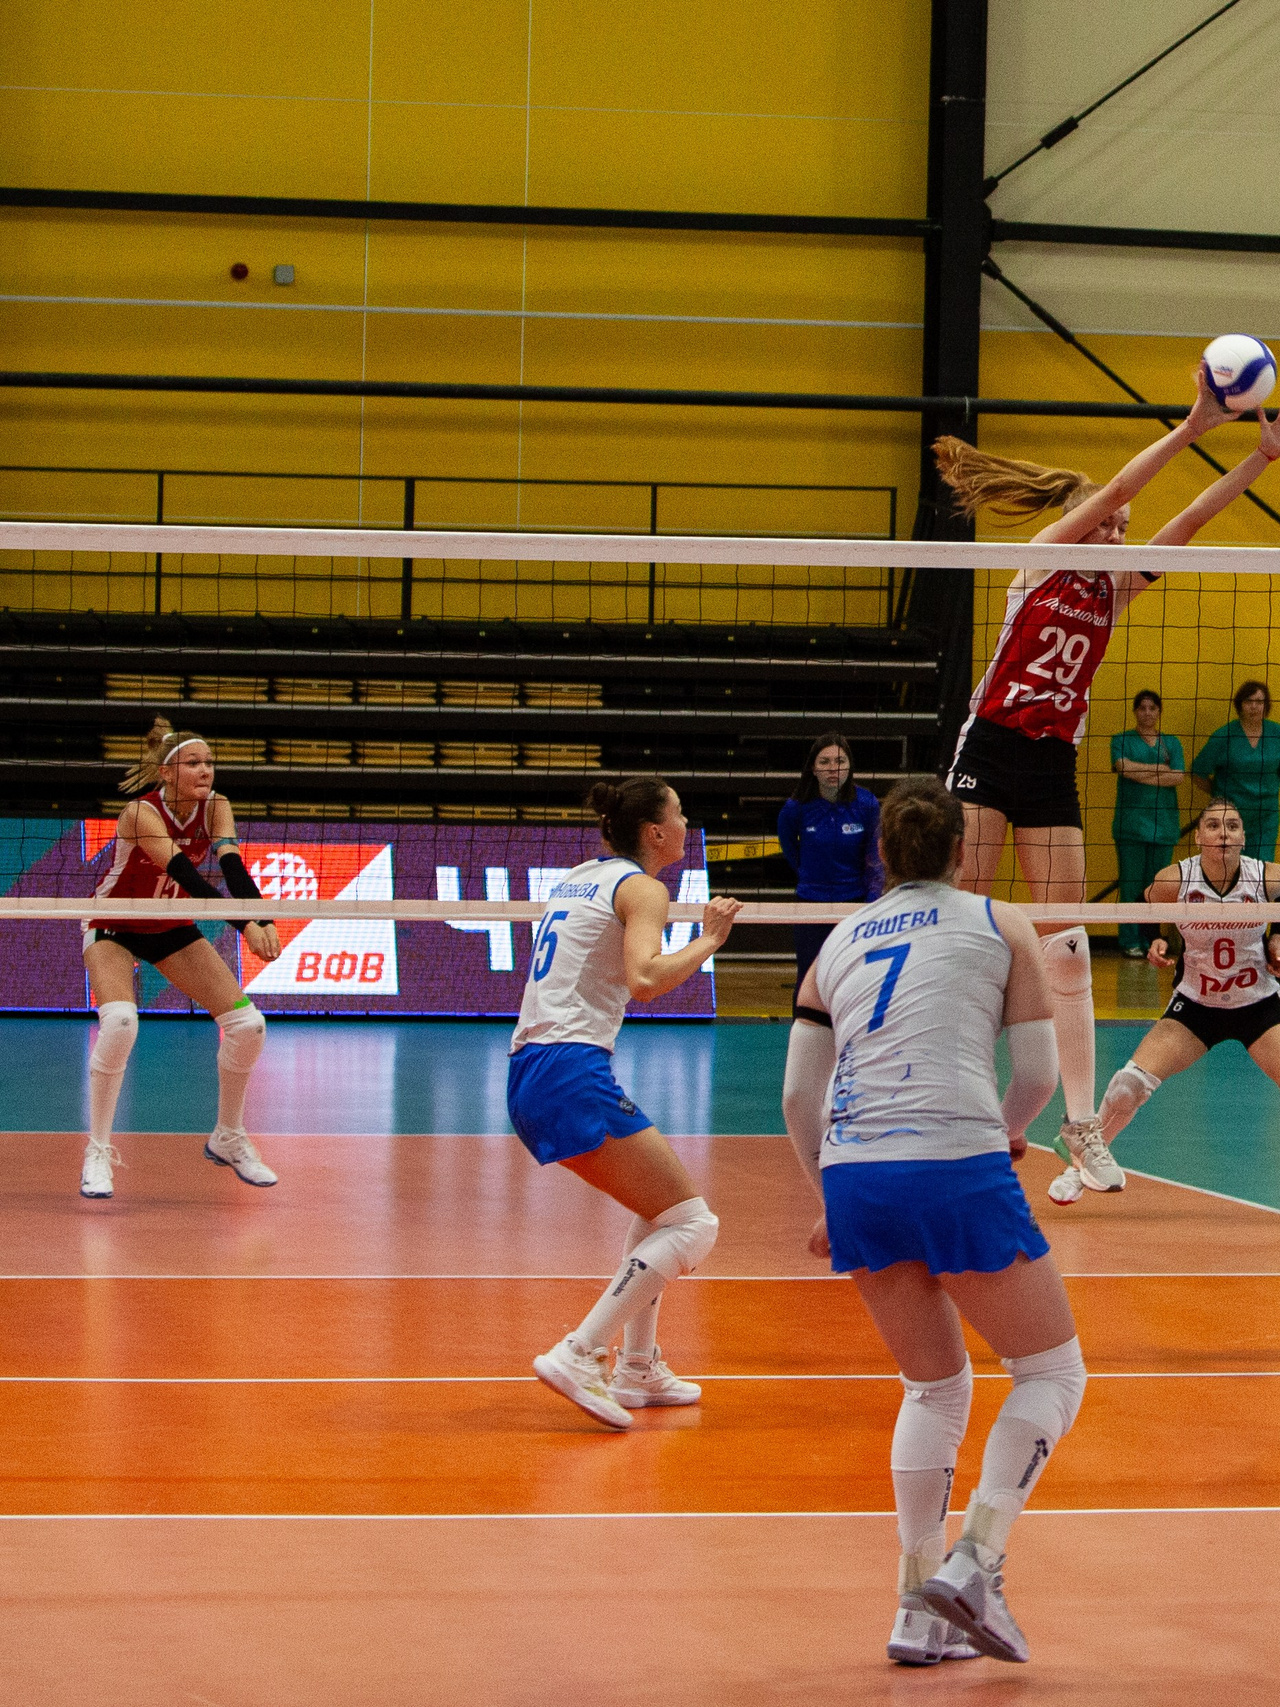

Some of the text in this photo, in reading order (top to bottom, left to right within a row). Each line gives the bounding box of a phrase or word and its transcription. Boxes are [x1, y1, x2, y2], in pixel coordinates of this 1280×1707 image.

[1026, 626, 1090, 685] 29
[851, 908, 939, 944] ГОШЕВА
[527, 911, 570, 983] 15
[1213, 938, 1236, 970] 6
[295, 951, 385, 983] ВФВ
[865, 943, 911, 1034] 7
[1173, 1001, 1184, 1012] 6
